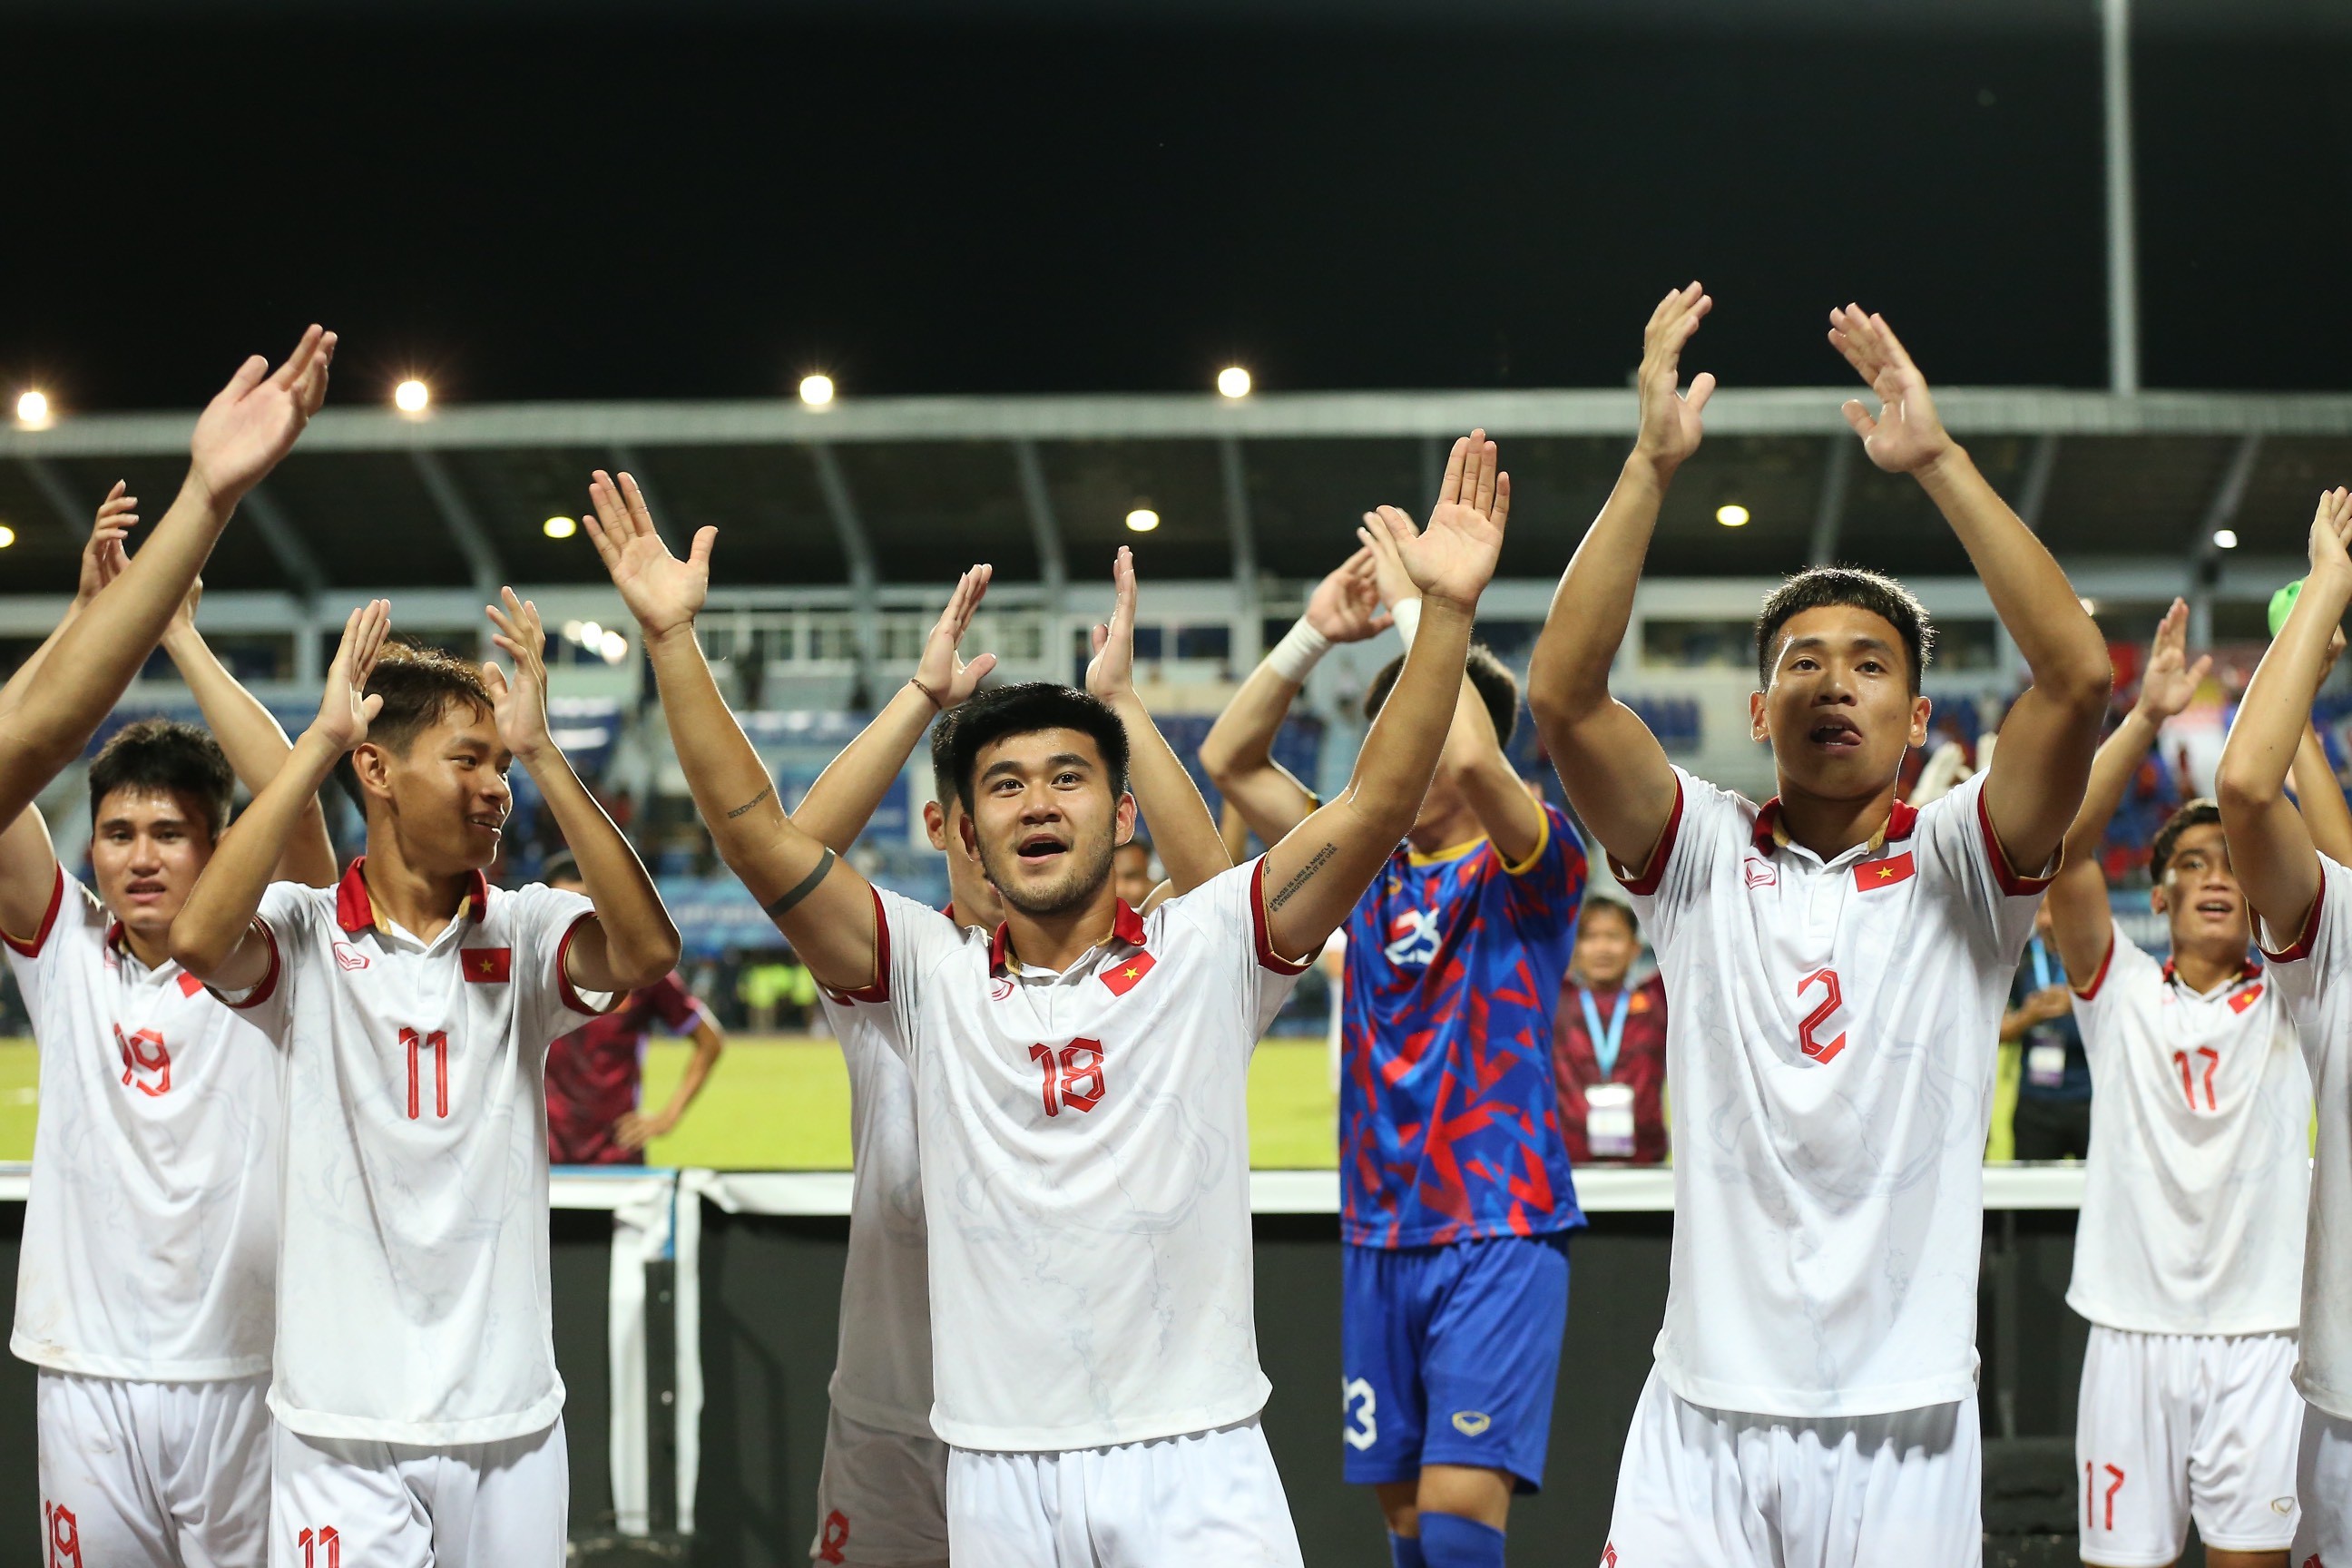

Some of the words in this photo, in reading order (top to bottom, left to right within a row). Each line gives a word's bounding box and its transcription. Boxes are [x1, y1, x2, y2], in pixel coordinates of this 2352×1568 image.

[1277, 870, 1315, 907] STRENGTHEN
[1325, 847, 1338, 858] USE
[1293, 868, 1307, 882] LIKE
[1309, 842, 1332, 866] MUSCLE
[1798, 967, 1846, 1064] 2
[113, 1023, 172, 1097] 19
[398, 1026, 448, 1120] 11
[1028, 1037, 1107, 1117] 18
[2173, 1046, 2220, 1111] 17
[1342, 1376, 1377, 1451] 3
[2085, 1460, 2124, 1531] 17
[45, 1500, 83, 1568] 19
